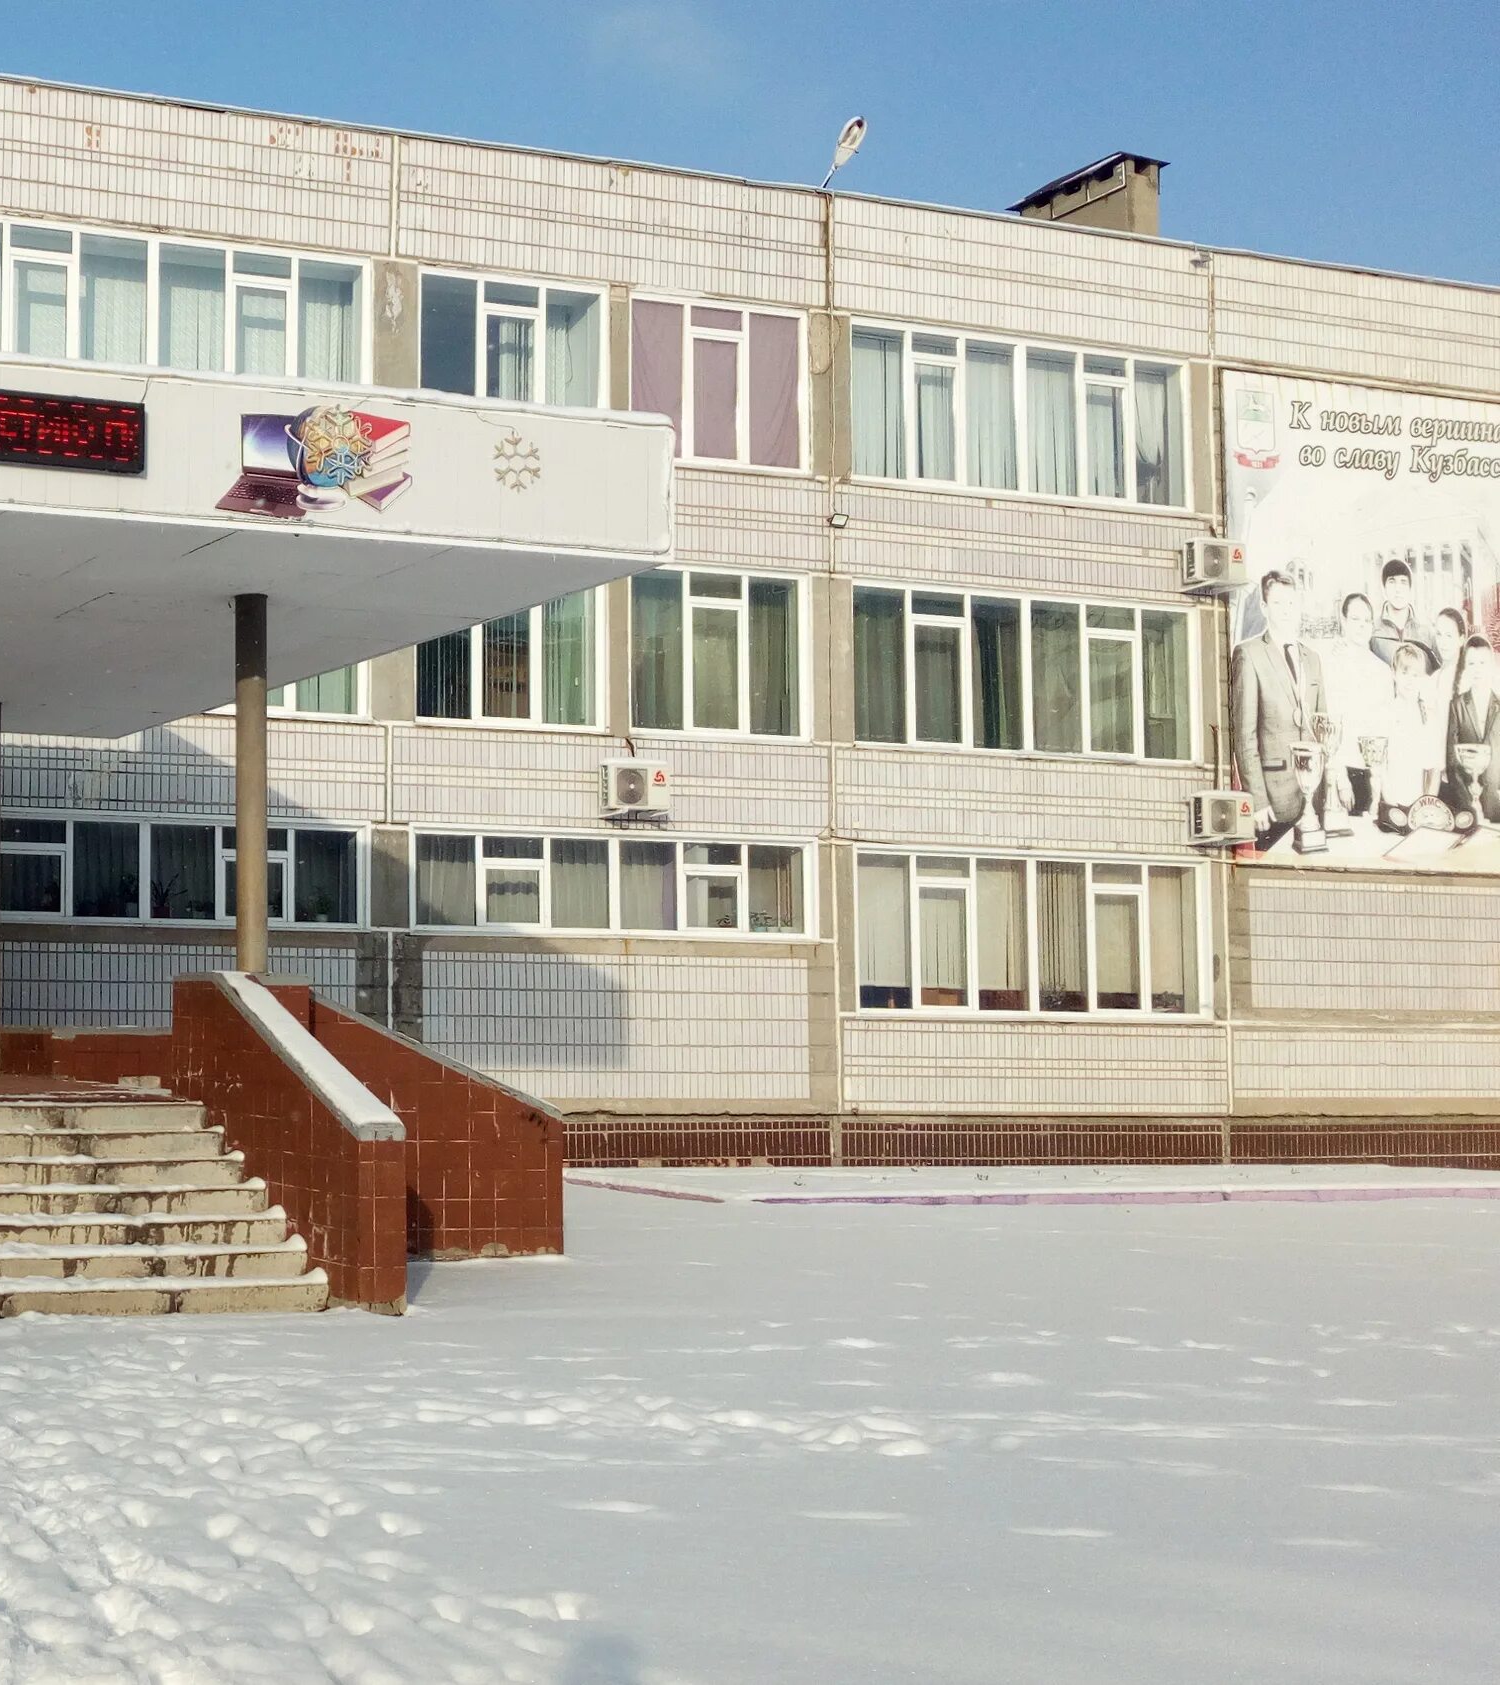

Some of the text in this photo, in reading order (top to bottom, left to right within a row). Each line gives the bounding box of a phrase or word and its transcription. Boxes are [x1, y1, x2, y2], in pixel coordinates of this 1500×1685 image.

[1289, 401, 1312, 430] К
[1320, 410, 1402, 436] новым
[1298, 444, 1326, 467] во
[1334, 447, 1400, 480] славу
